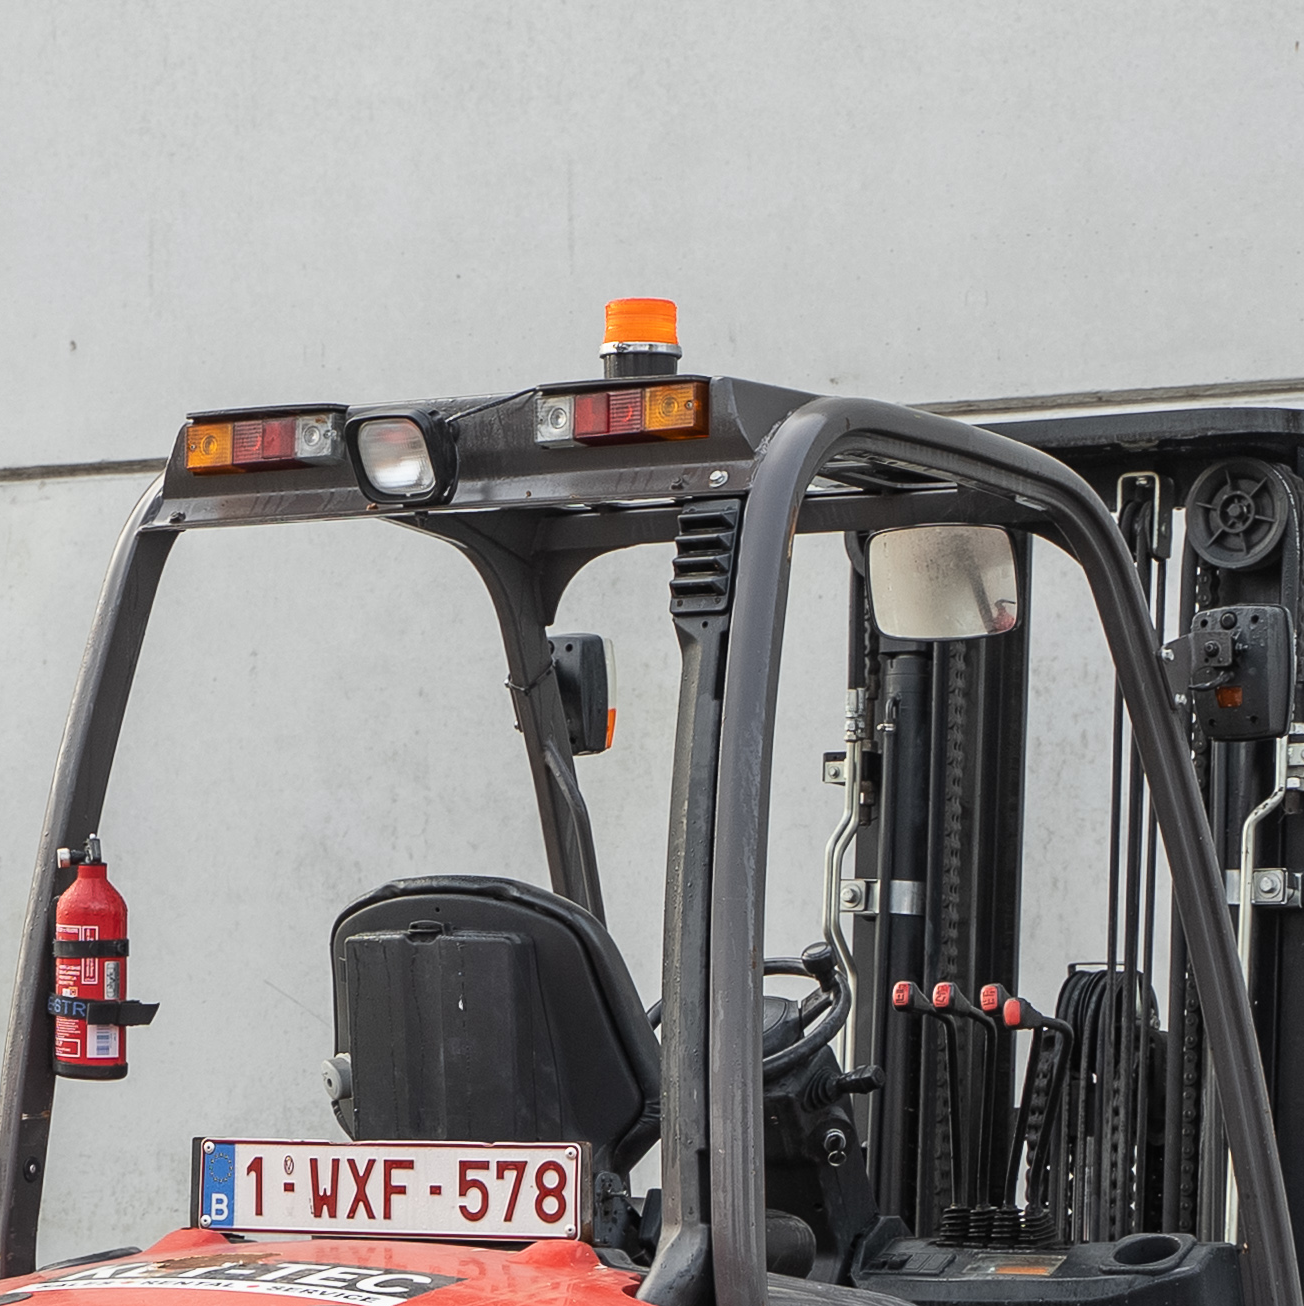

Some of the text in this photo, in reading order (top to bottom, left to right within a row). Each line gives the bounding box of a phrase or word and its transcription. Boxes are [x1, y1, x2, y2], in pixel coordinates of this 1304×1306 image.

[246, 1155, 567, 1223] 1-WXF-578
[211, 1192, 229, 1221] B
[141, 1280, 235, 1289] RENTAL
[266, 1285, 381, 1304] SERVICE
